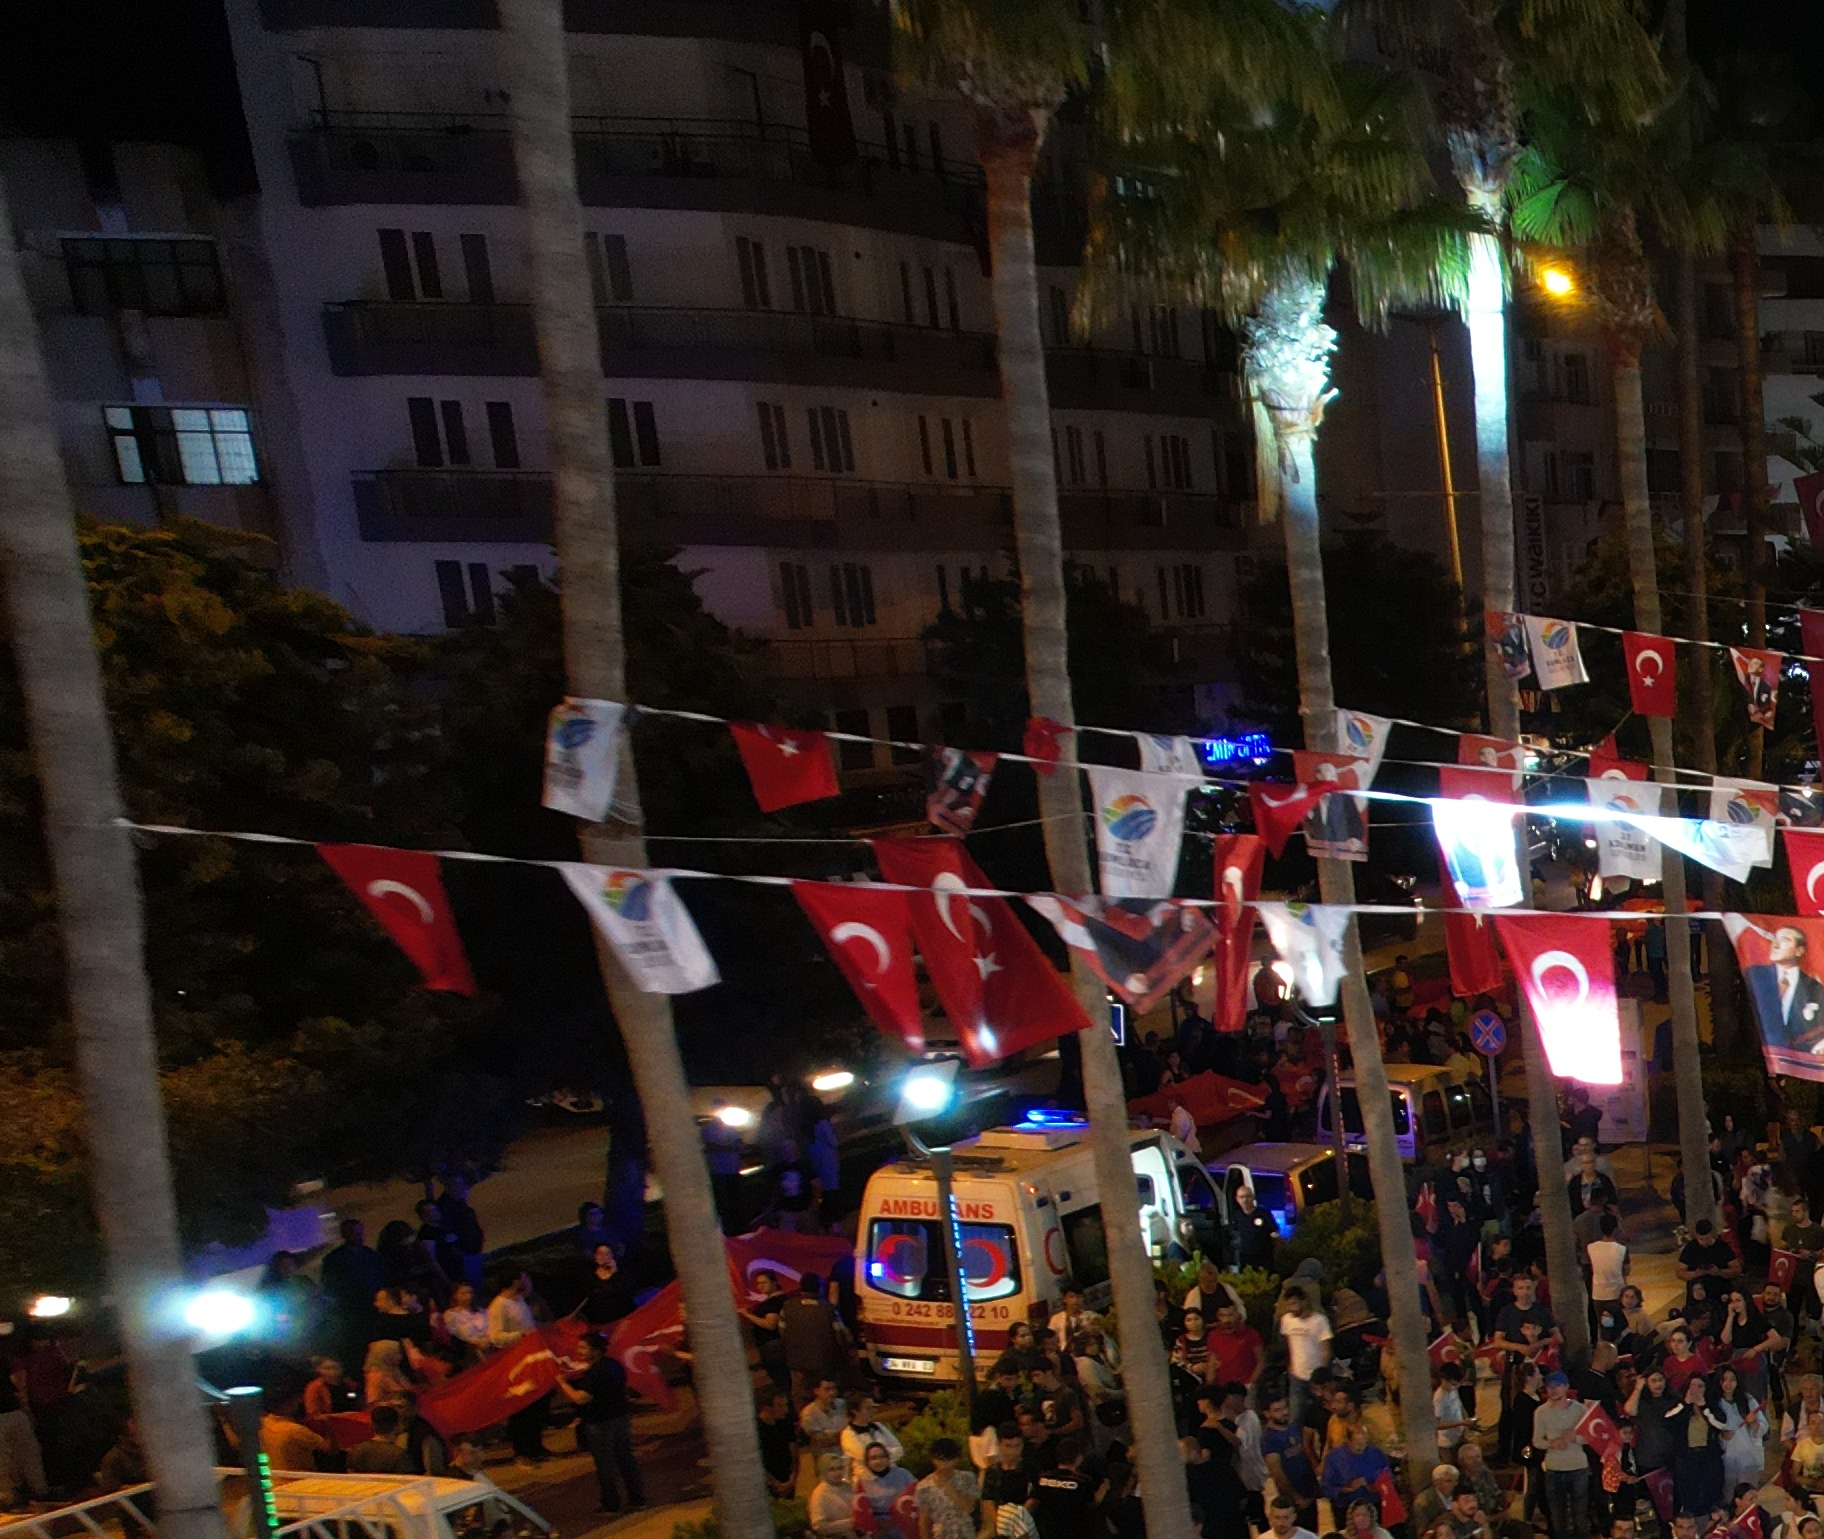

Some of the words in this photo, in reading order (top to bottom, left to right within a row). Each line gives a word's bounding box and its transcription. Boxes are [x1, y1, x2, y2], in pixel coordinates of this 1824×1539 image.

[880, 1199, 995, 1219] AMBUANS
[892, 1302, 901, 1316] 0
[906, 1304, 931, 1317] 242
[937, 1305, 956, 1318] 88
[991, 1306, 1009, 1319] 10
